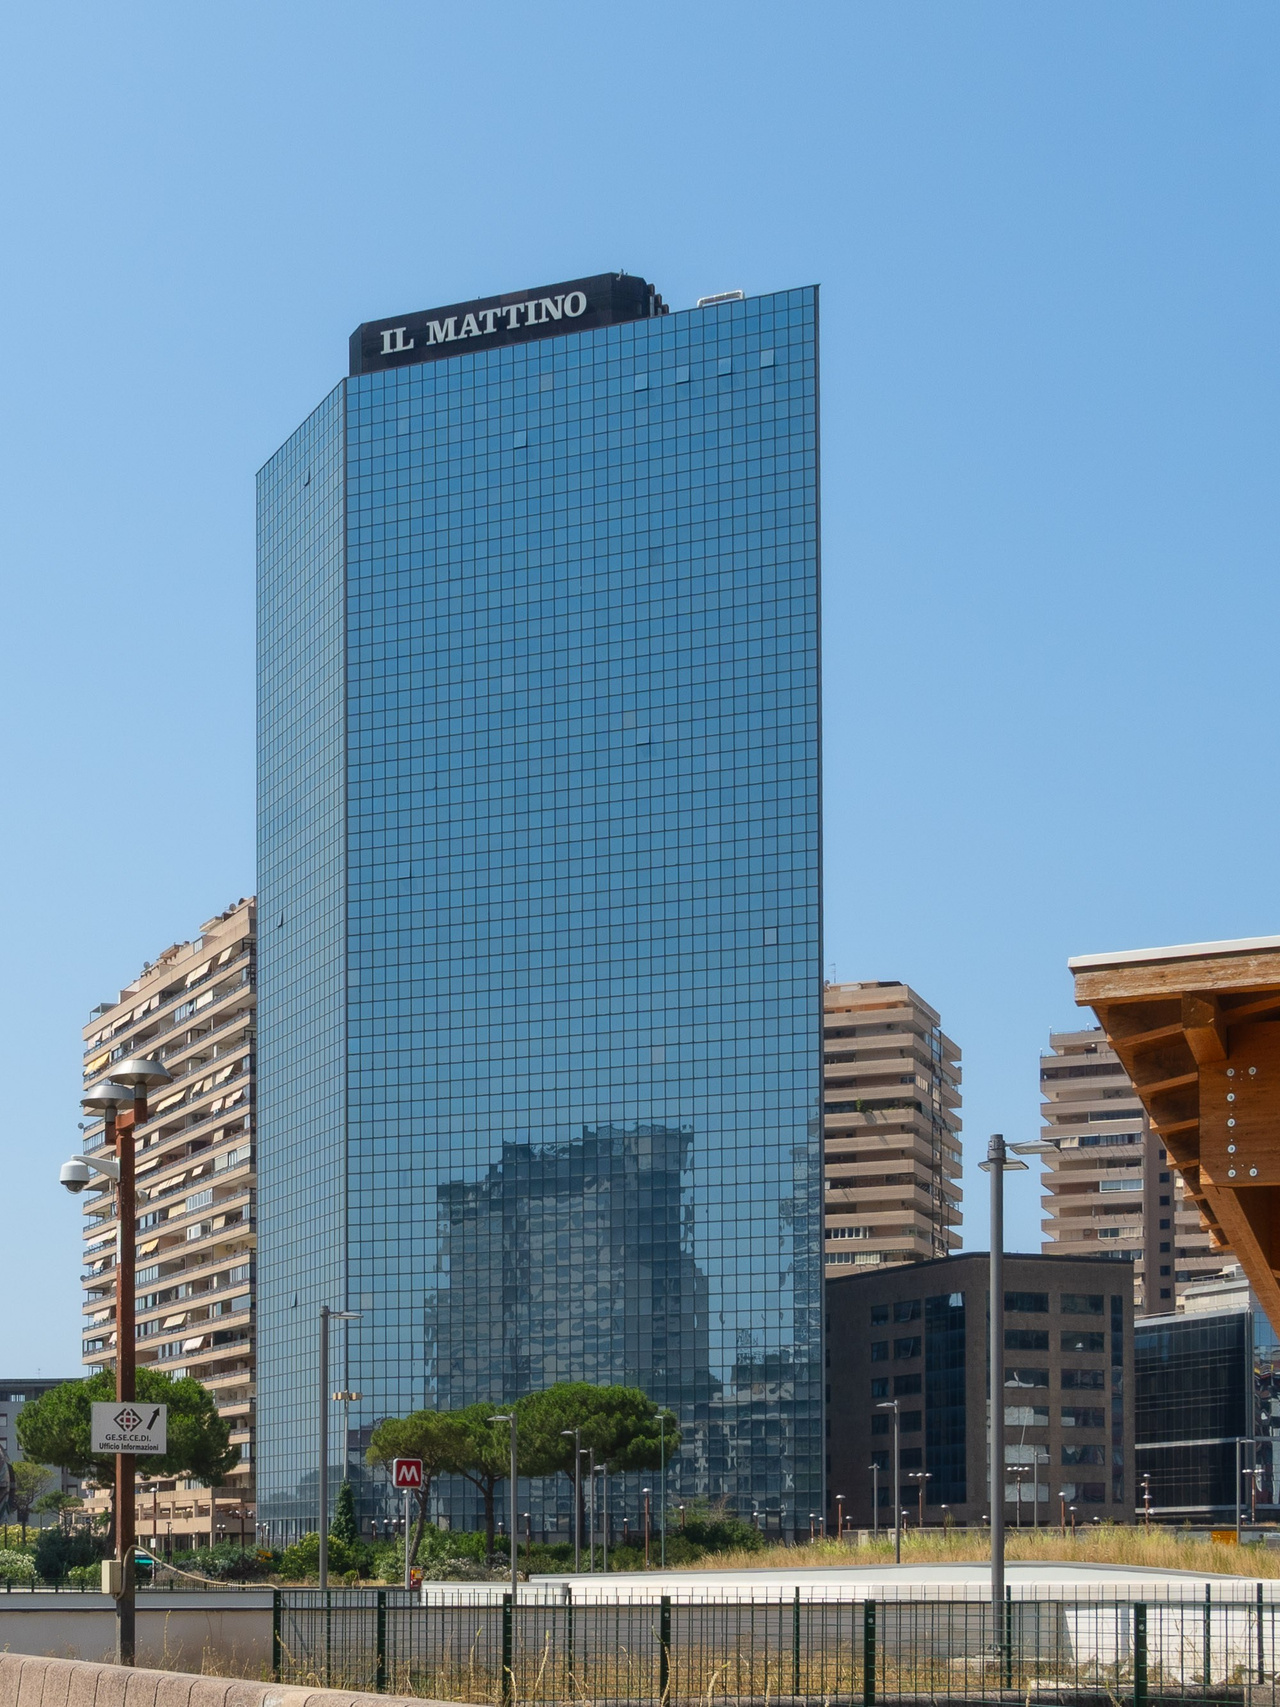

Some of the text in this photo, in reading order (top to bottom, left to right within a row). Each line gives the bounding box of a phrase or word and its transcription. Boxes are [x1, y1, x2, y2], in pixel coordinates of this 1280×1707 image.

[380, 291, 587, 355] IL MATTINO
[99, 1442, 159, 1451] Ufficio Informazioni
[398, 1465, 419, 1481] M
